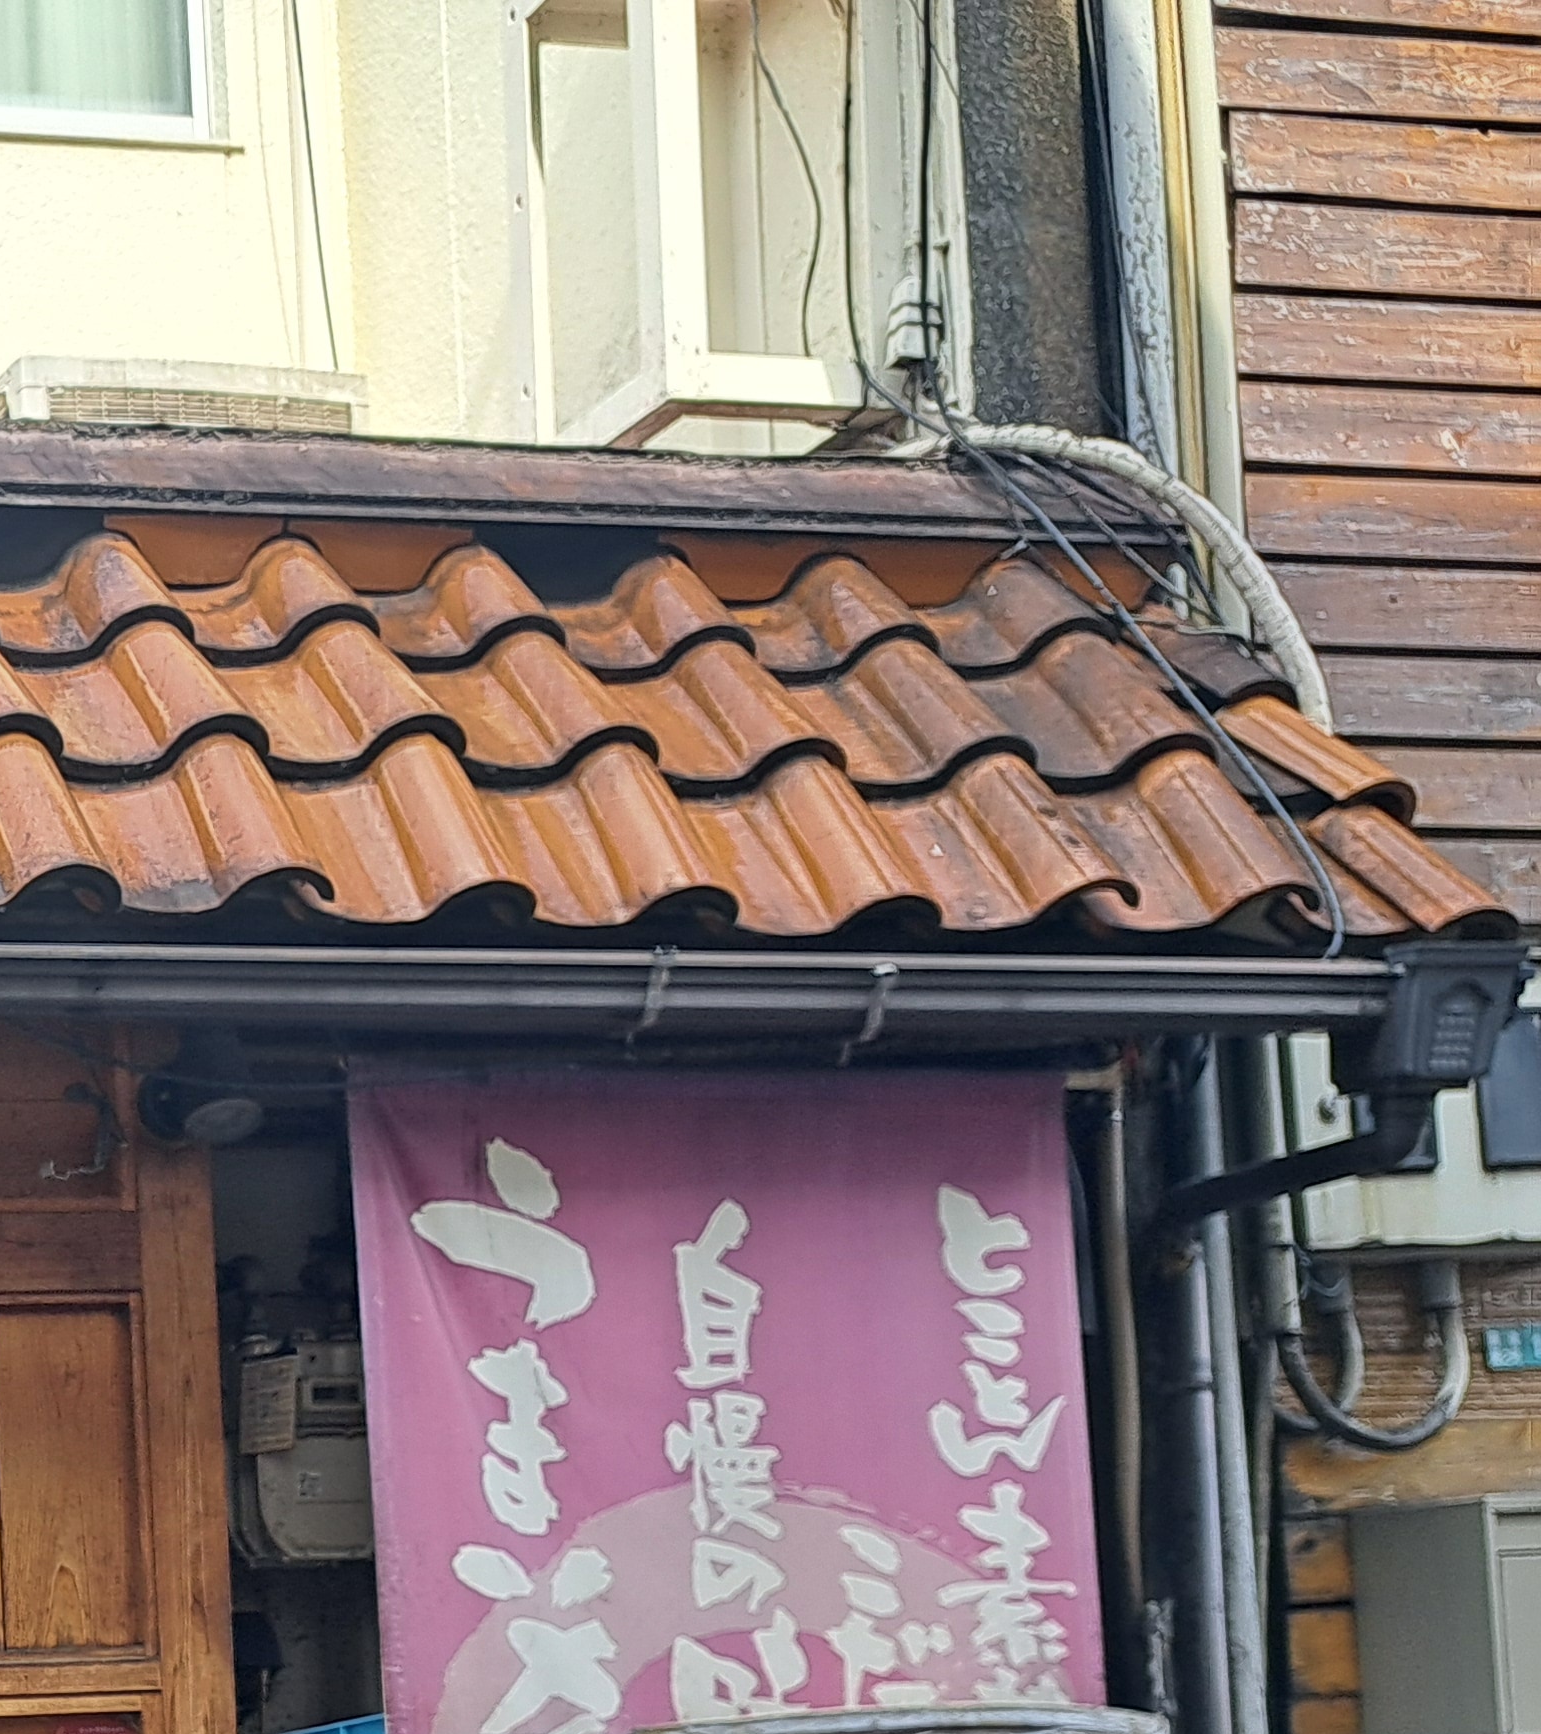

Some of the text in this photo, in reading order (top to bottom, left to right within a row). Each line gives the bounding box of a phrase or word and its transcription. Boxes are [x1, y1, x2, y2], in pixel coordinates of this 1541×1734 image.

[928, 1183, 1079, 1706] とことん素
